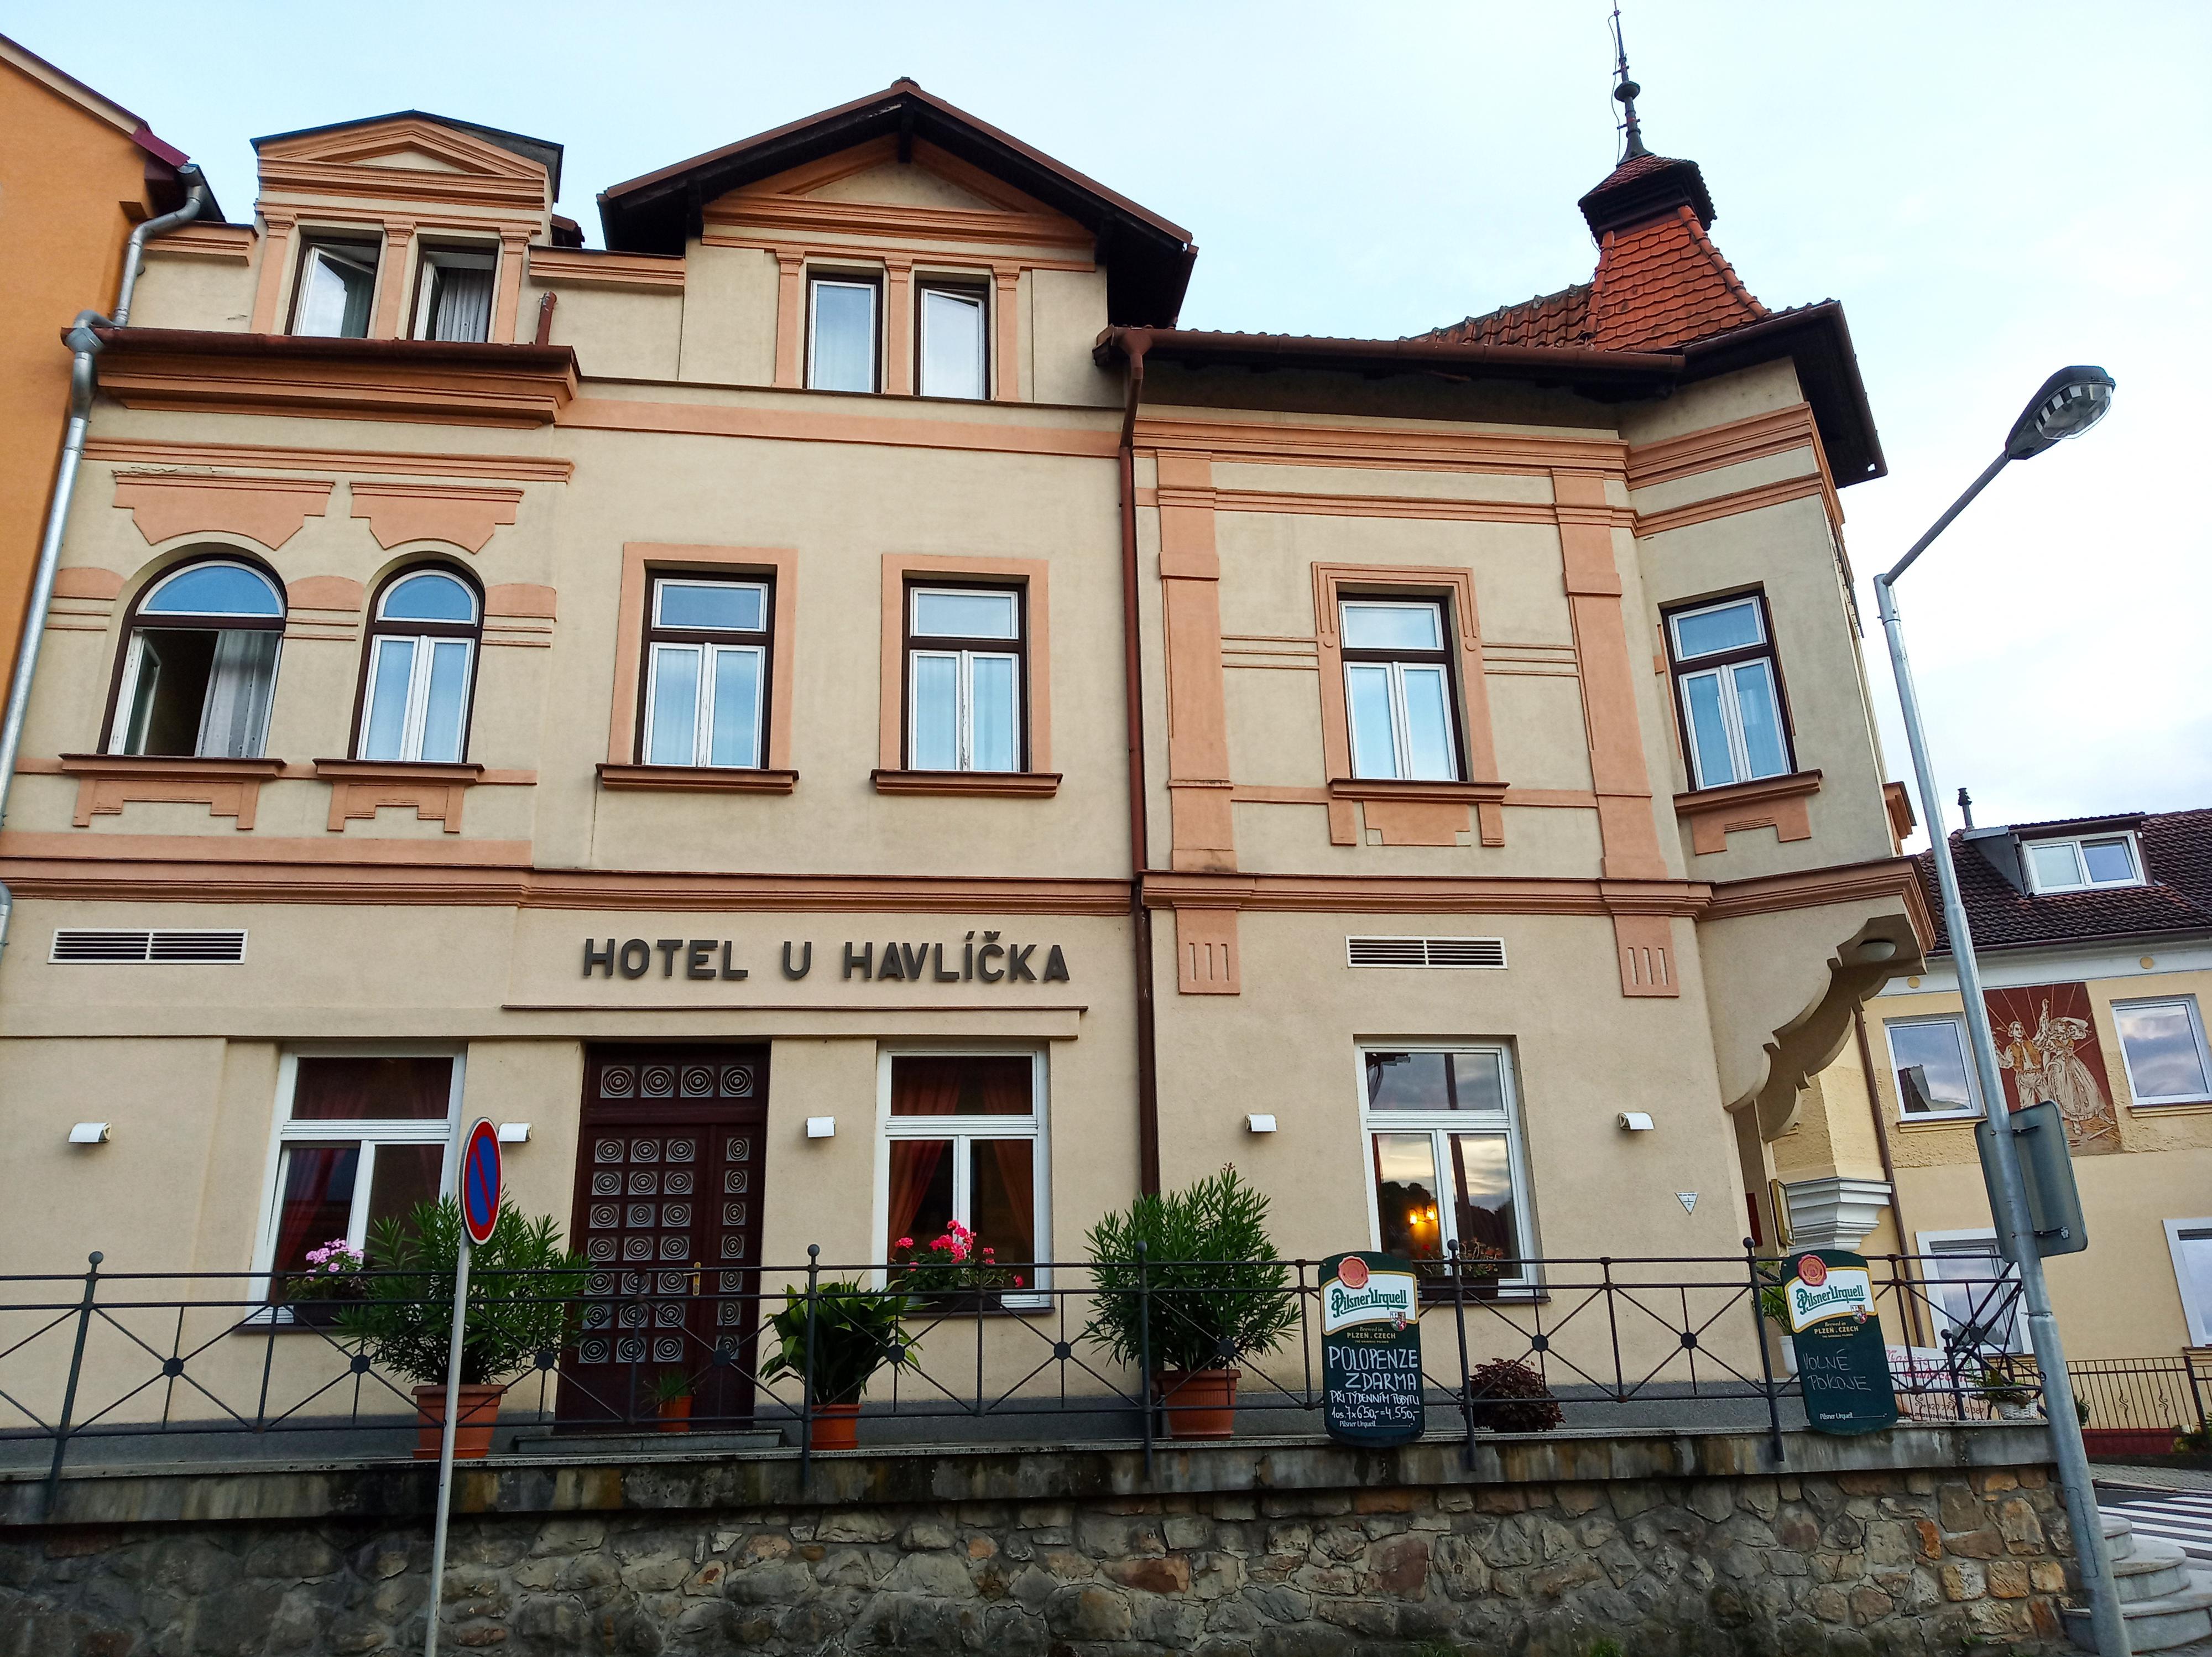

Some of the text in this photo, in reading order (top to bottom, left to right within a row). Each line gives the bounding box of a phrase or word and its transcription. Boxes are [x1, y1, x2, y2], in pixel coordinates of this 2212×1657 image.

[583, 930, 1070, 982] HOTEL U HAVLÍČKA
[1331, 1287, 1407, 1318] Pilsner Urquell
[1796, 1284, 1864, 1315] Pilsner Urquell
[1328, 1346, 1418, 1371] POLOPENZE
[1802, 1348, 1851, 1371] VOLNÉ
[1345, 1373, 1417, 1392] ZDARMA
[1807, 1374, 1871, 1392] POKOJE
[1357, 1420, 1376, 1429] Urquell
